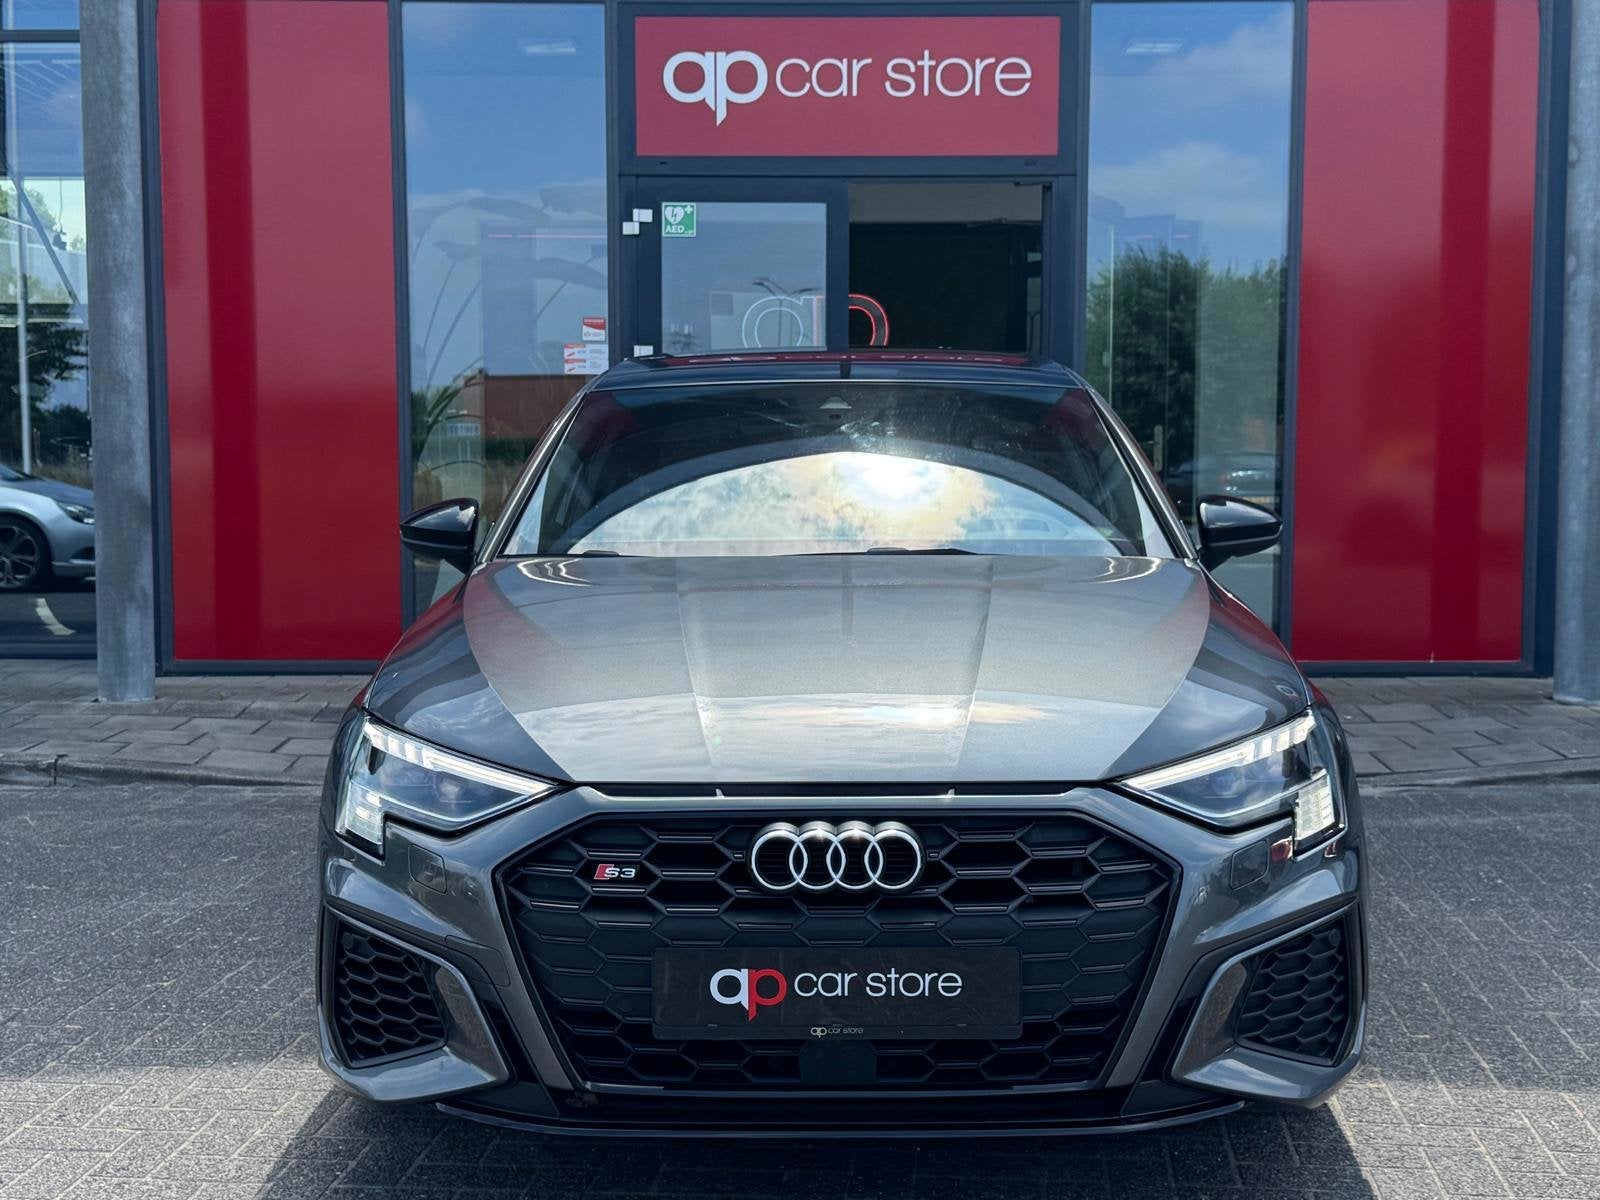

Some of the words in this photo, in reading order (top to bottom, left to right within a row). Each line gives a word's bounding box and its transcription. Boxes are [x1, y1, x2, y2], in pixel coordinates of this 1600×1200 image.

[662, 50, 768, 126] ap
[775, 57, 872, 97] car
[885, 49, 1032, 97] store
[665, 224, 685, 233] AED
[603, 866, 636, 879] S3
[709, 968, 788, 1021] ap
[794, 972, 858, 997] car
[866, 967, 963, 997] store
